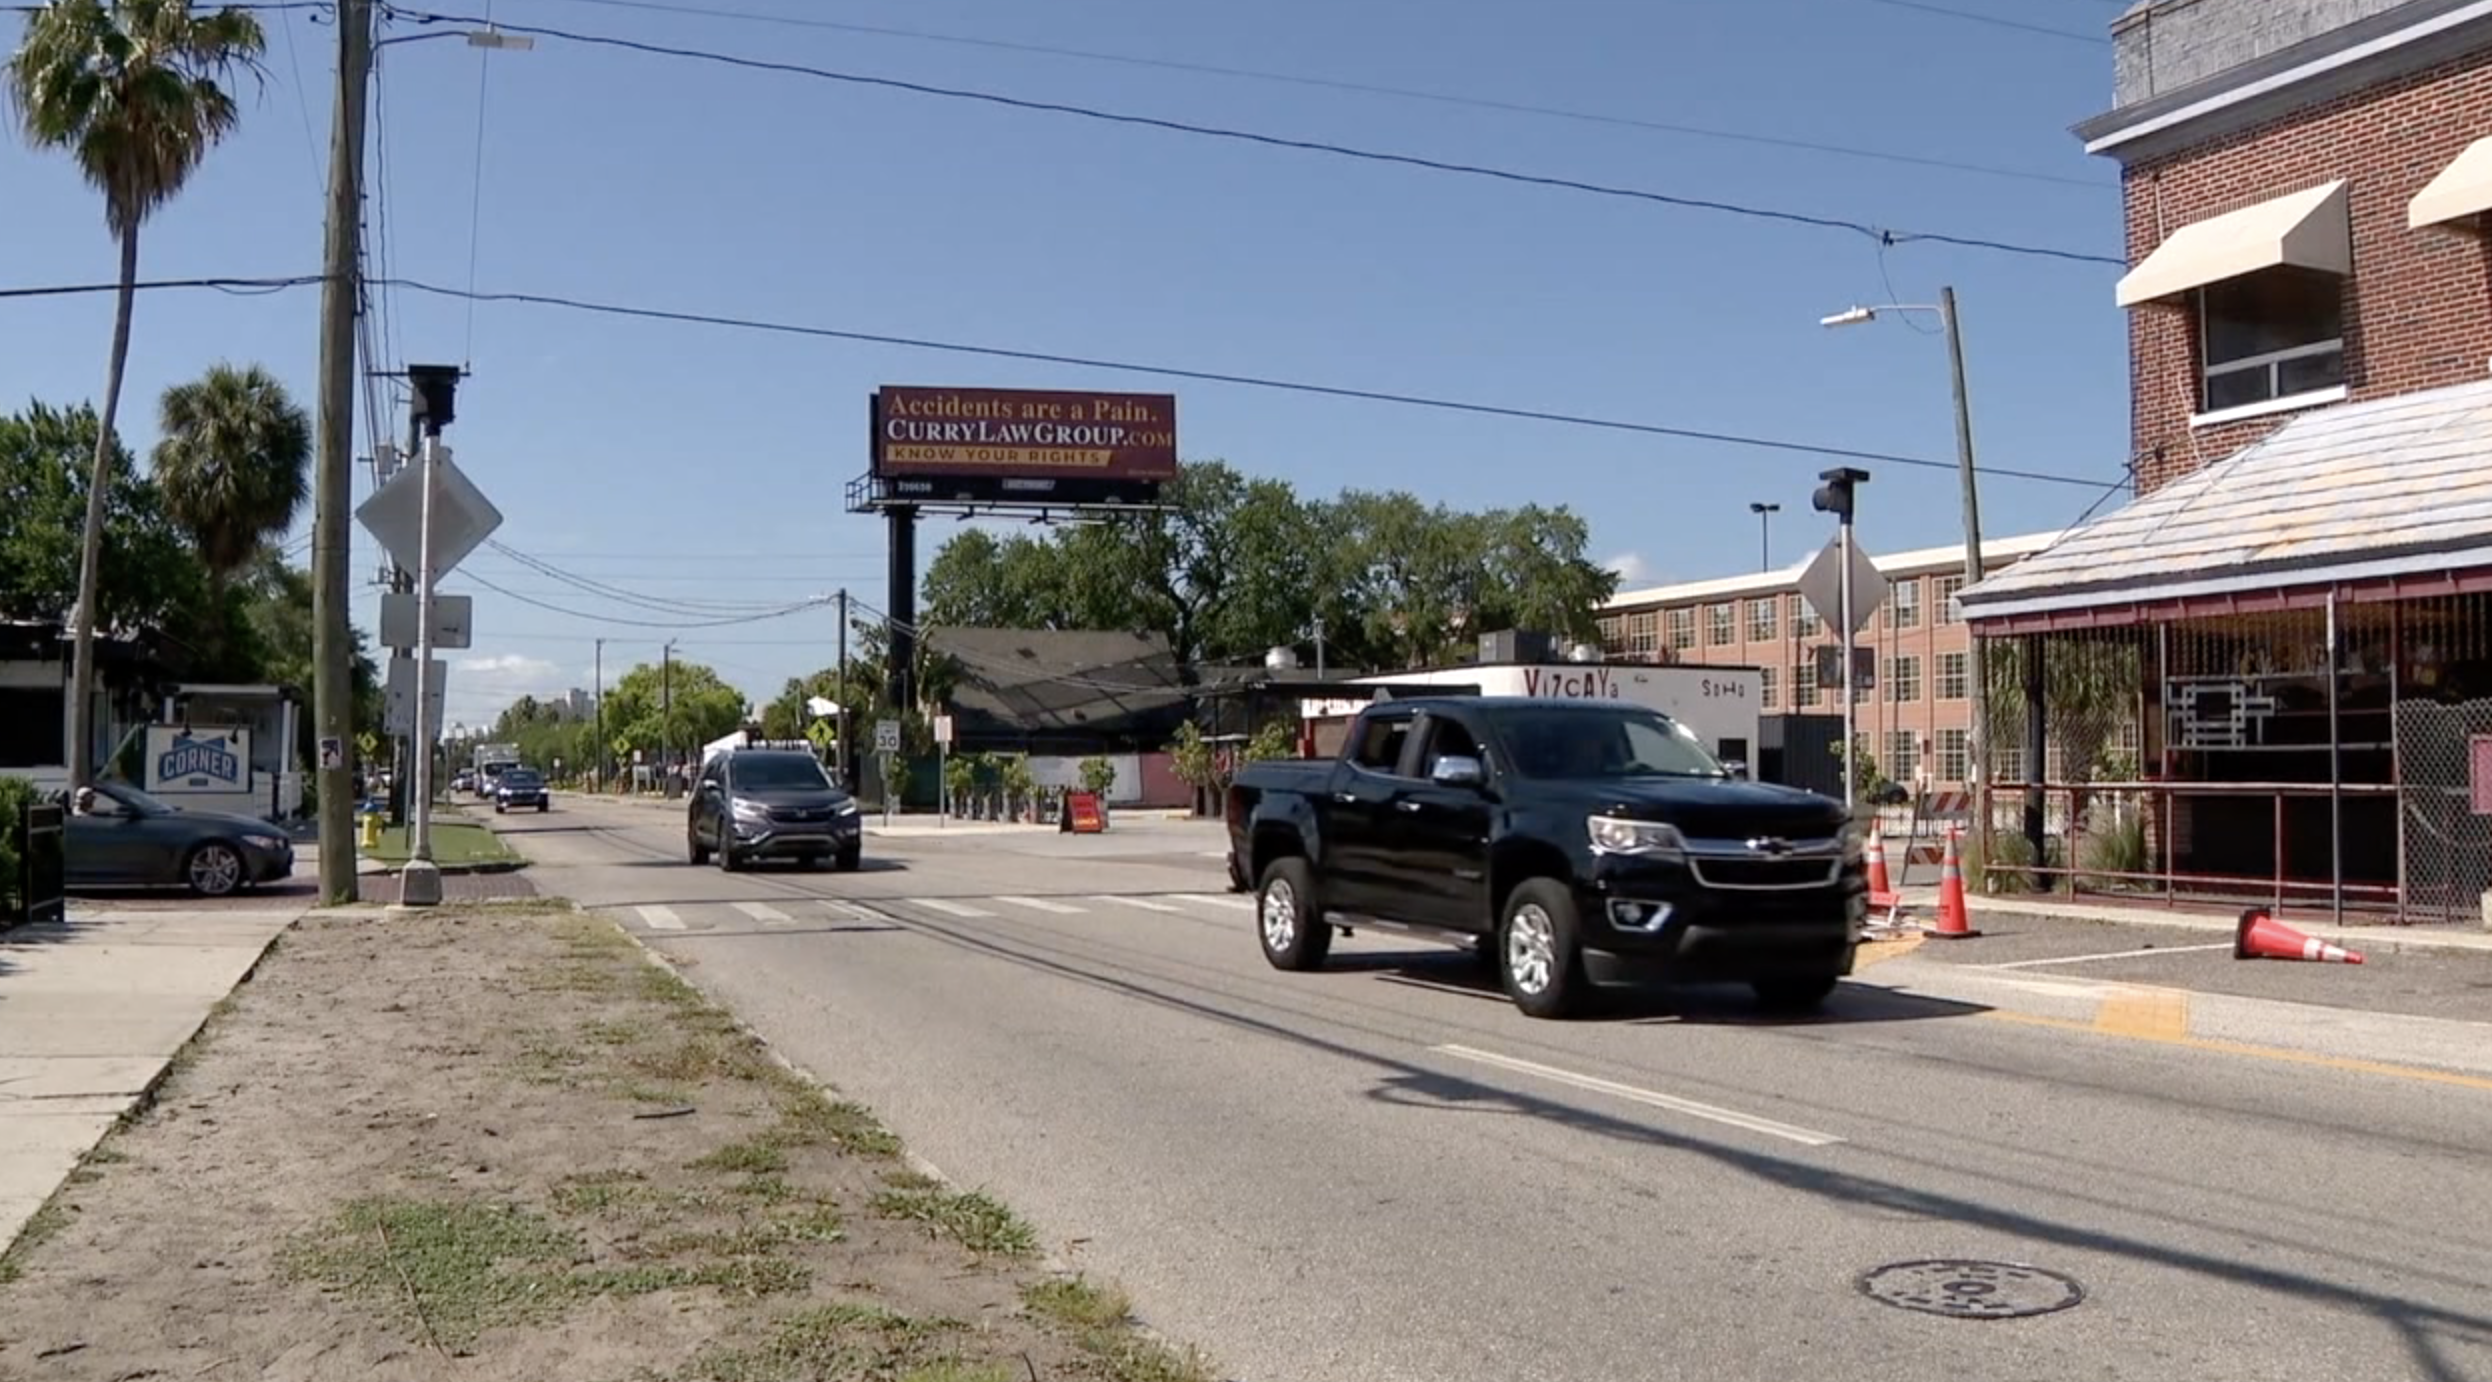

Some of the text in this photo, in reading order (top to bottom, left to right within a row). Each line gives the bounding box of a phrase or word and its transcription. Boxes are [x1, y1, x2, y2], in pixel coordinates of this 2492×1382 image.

[890, 395, 1158, 422] Accidents are a Pain.
[894, 448, 1101, 464] KNOW YOUR RIGHTS
[879, 735, 897, 748] 30
[164, 747, 233, 780] CORNER
